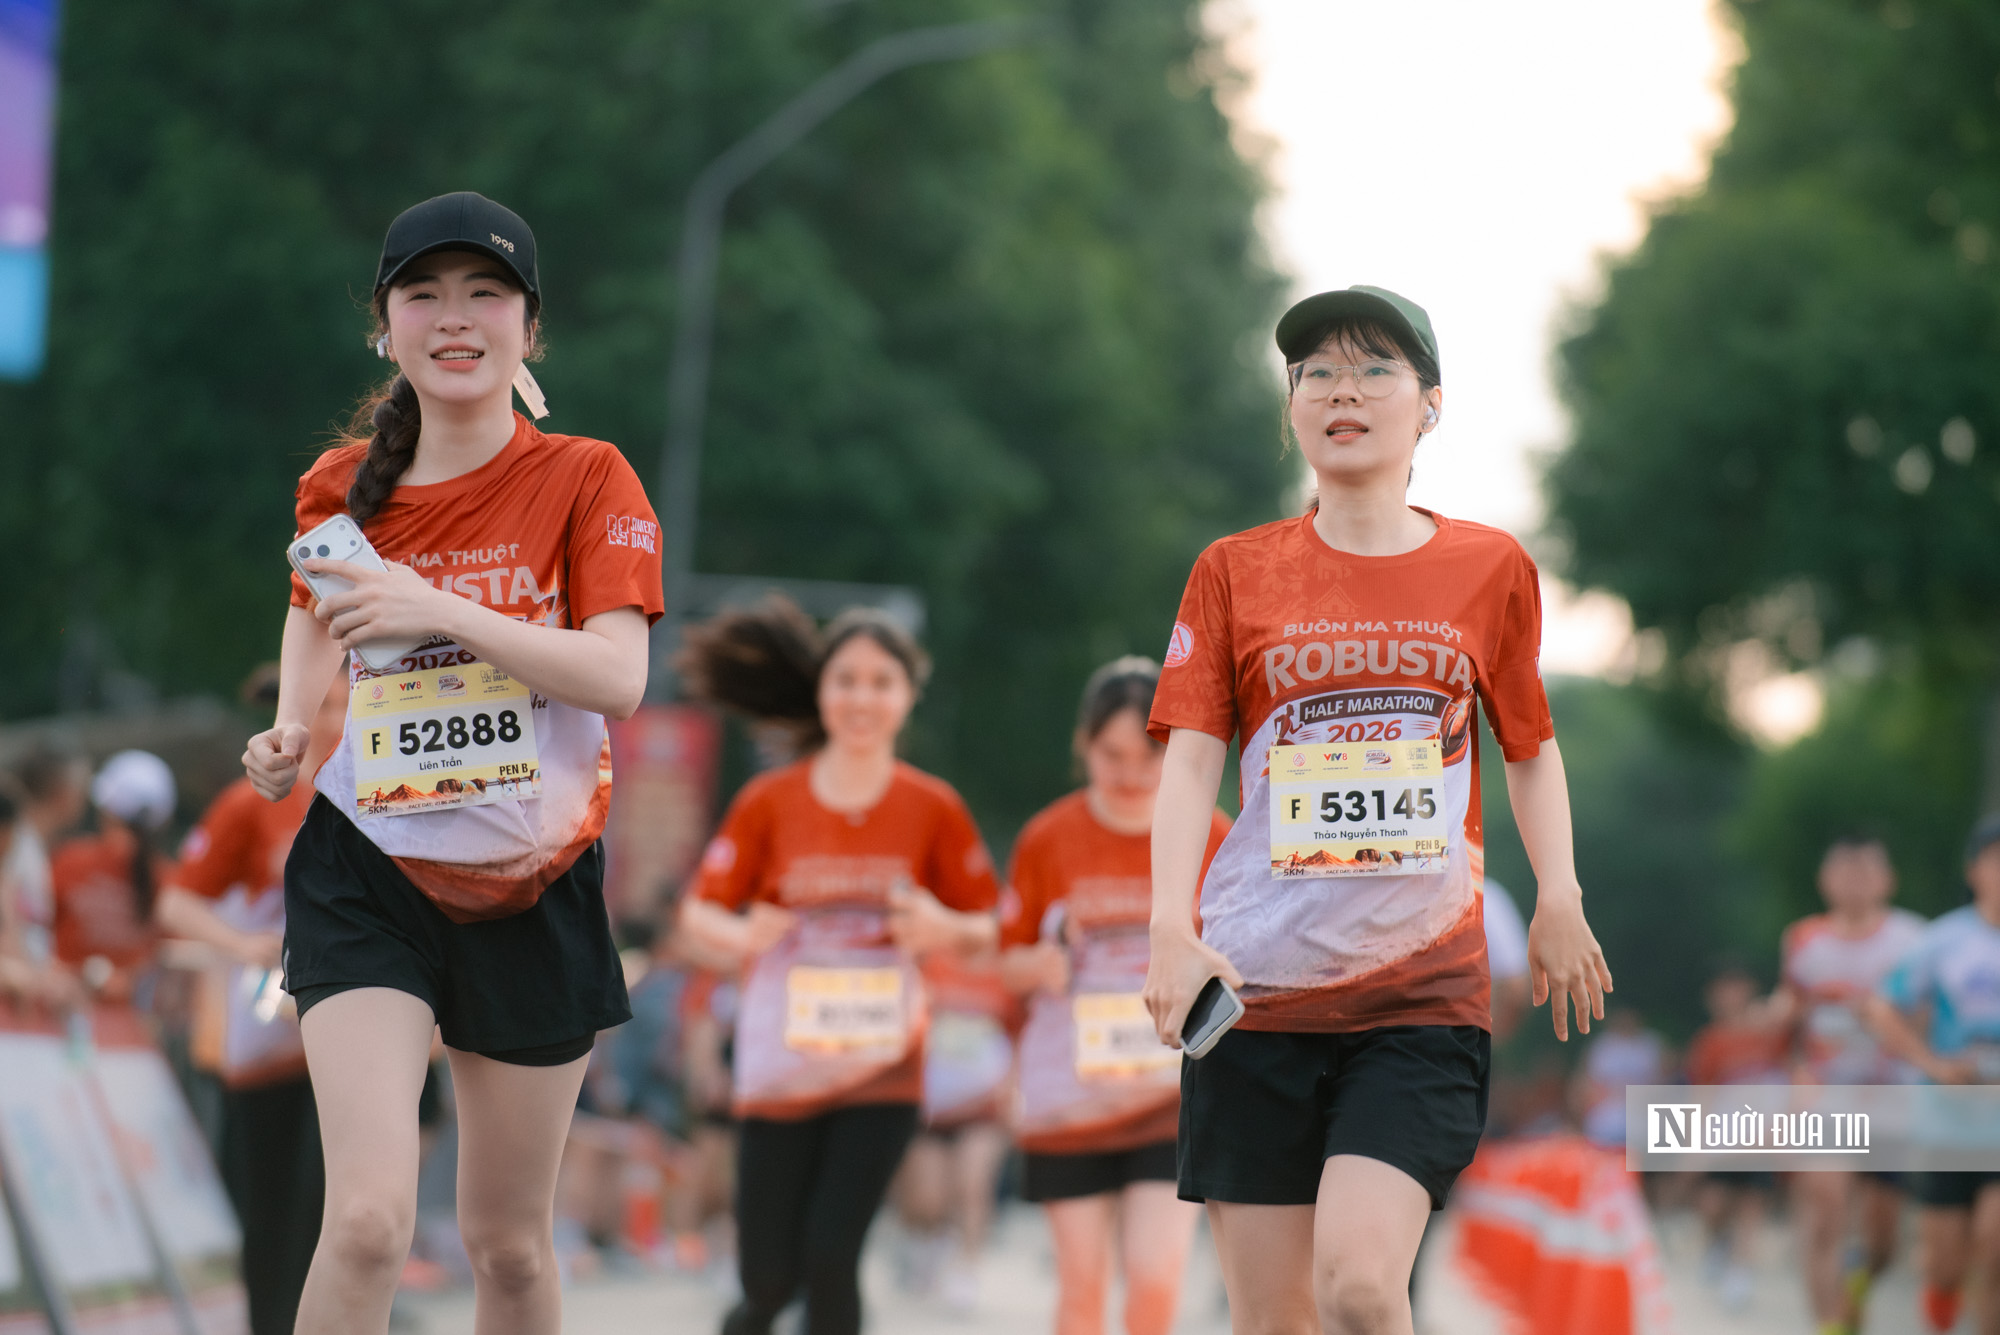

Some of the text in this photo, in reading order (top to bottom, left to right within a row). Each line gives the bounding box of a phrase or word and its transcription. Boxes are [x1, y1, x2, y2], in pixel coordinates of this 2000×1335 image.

[490, 232, 515, 253] 1998
[410, 552, 445, 568] MA
[448, 543, 520, 565] THUỘT
[422, 566, 543, 605] USTA
[1283, 618, 1463, 644] BUÔN MA THUỘT
[400, 649, 477, 673] 2026
[1263, 639, 1473, 698] ROBUSTA
[1304, 695, 1435, 720] HALF MARATHON
[371, 709, 522, 756] F 52888
[1327, 719, 1402, 744] 2026
[419, 760, 439, 771] Liên
[499, 763, 528, 776] PEN B
[368, 804, 388, 815] 5KM
[1291, 787, 1436, 823] F 53145
[1313, 828, 1408, 840] Thảo Nguyễn Thanh
[1415, 839, 1440, 850] PEN B
[1283, 868, 1305, 877] 5KM
